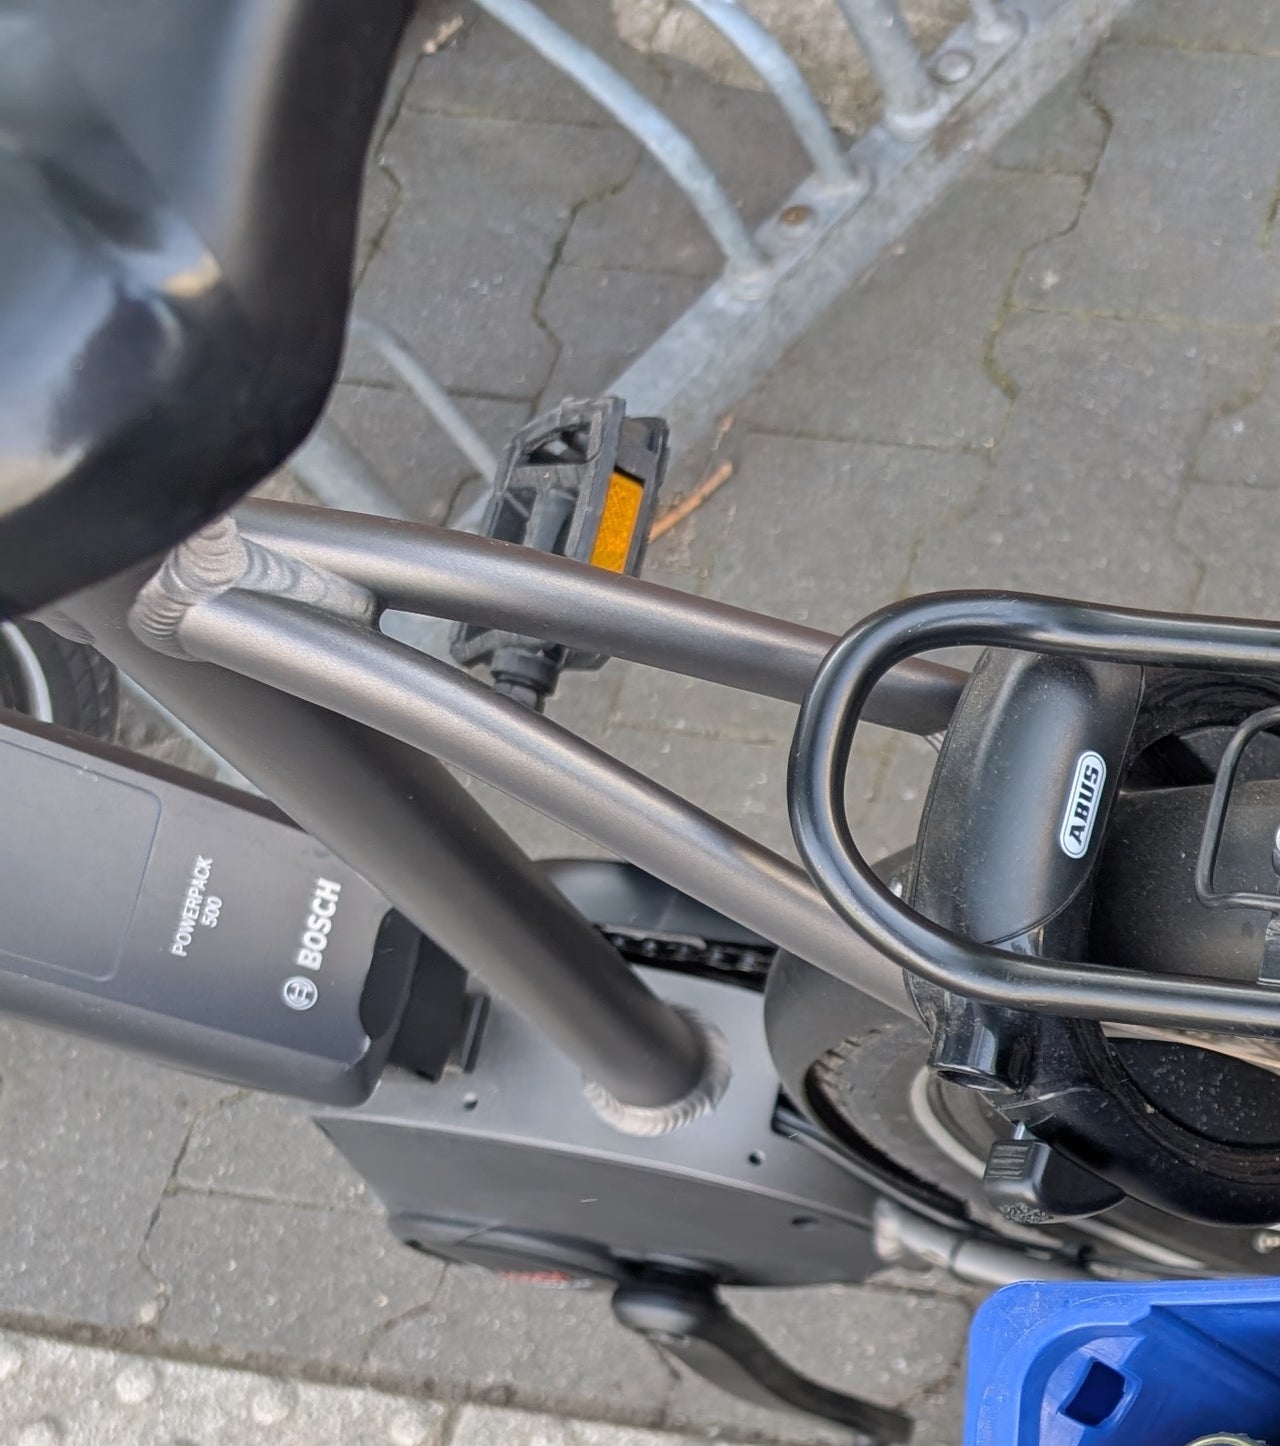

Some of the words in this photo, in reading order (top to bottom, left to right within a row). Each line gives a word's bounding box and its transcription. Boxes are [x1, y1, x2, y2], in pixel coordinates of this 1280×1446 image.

[1068, 764, 1100, 846] ABUS
[171, 855, 213, 957] POWERPACK
[201, 895, 223, 928] 500
[297, 876, 342, 971] BOSCH
